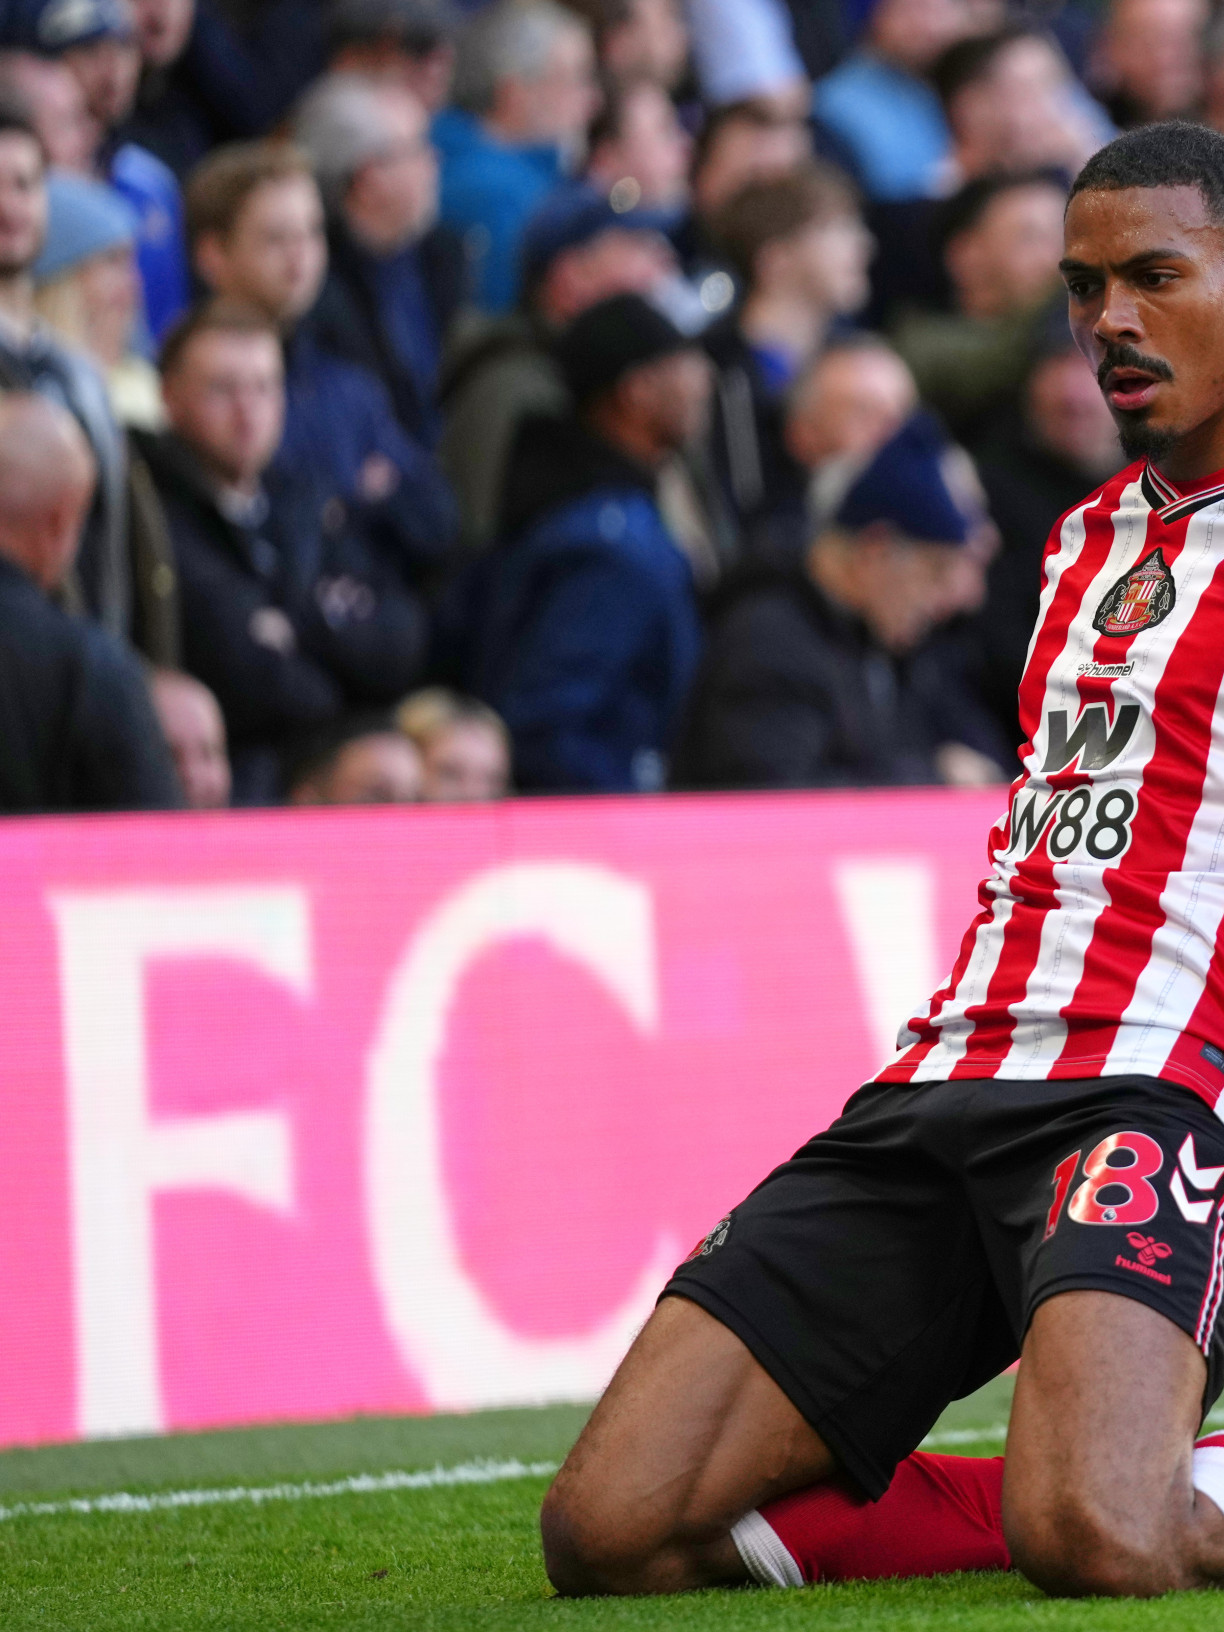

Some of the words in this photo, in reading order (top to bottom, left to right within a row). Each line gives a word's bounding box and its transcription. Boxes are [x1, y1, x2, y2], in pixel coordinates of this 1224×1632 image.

[1087, 660, 1136, 677] hummel
[1005, 787, 1135, 860] W88
[46, 861, 680, 1438] FC
[1042, 1131, 1164, 1243] 18
[1115, 1254, 1172, 1285] hummel
